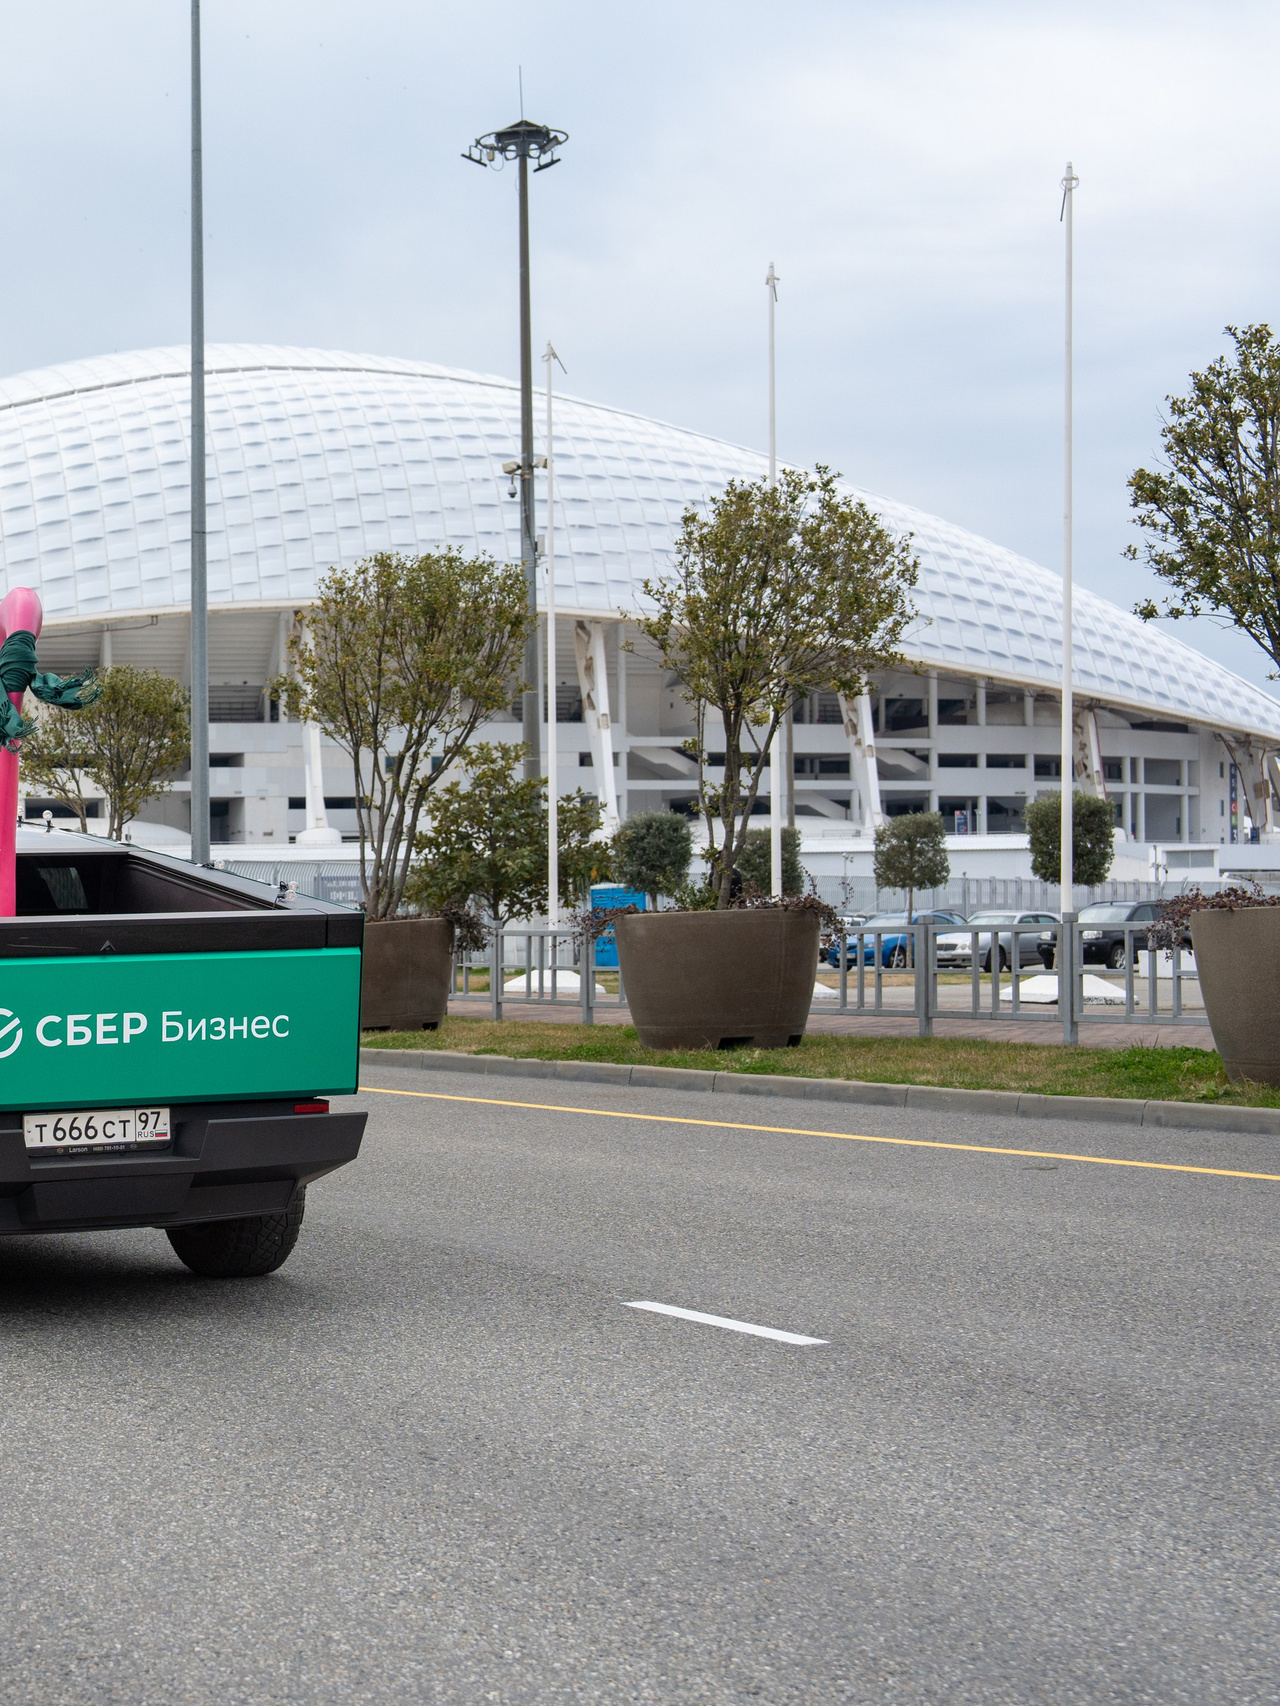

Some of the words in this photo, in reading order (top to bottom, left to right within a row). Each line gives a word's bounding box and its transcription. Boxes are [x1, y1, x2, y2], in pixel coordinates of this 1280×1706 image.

[35, 1012, 148, 1047] СБЕР
[161, 1010, 290, 1043] Бизнес
[34, 1115, 131, 1143] Т666СТ
[138, 1111, 161, 1131] 97
[137, 1130, 155, 1139] RUS
